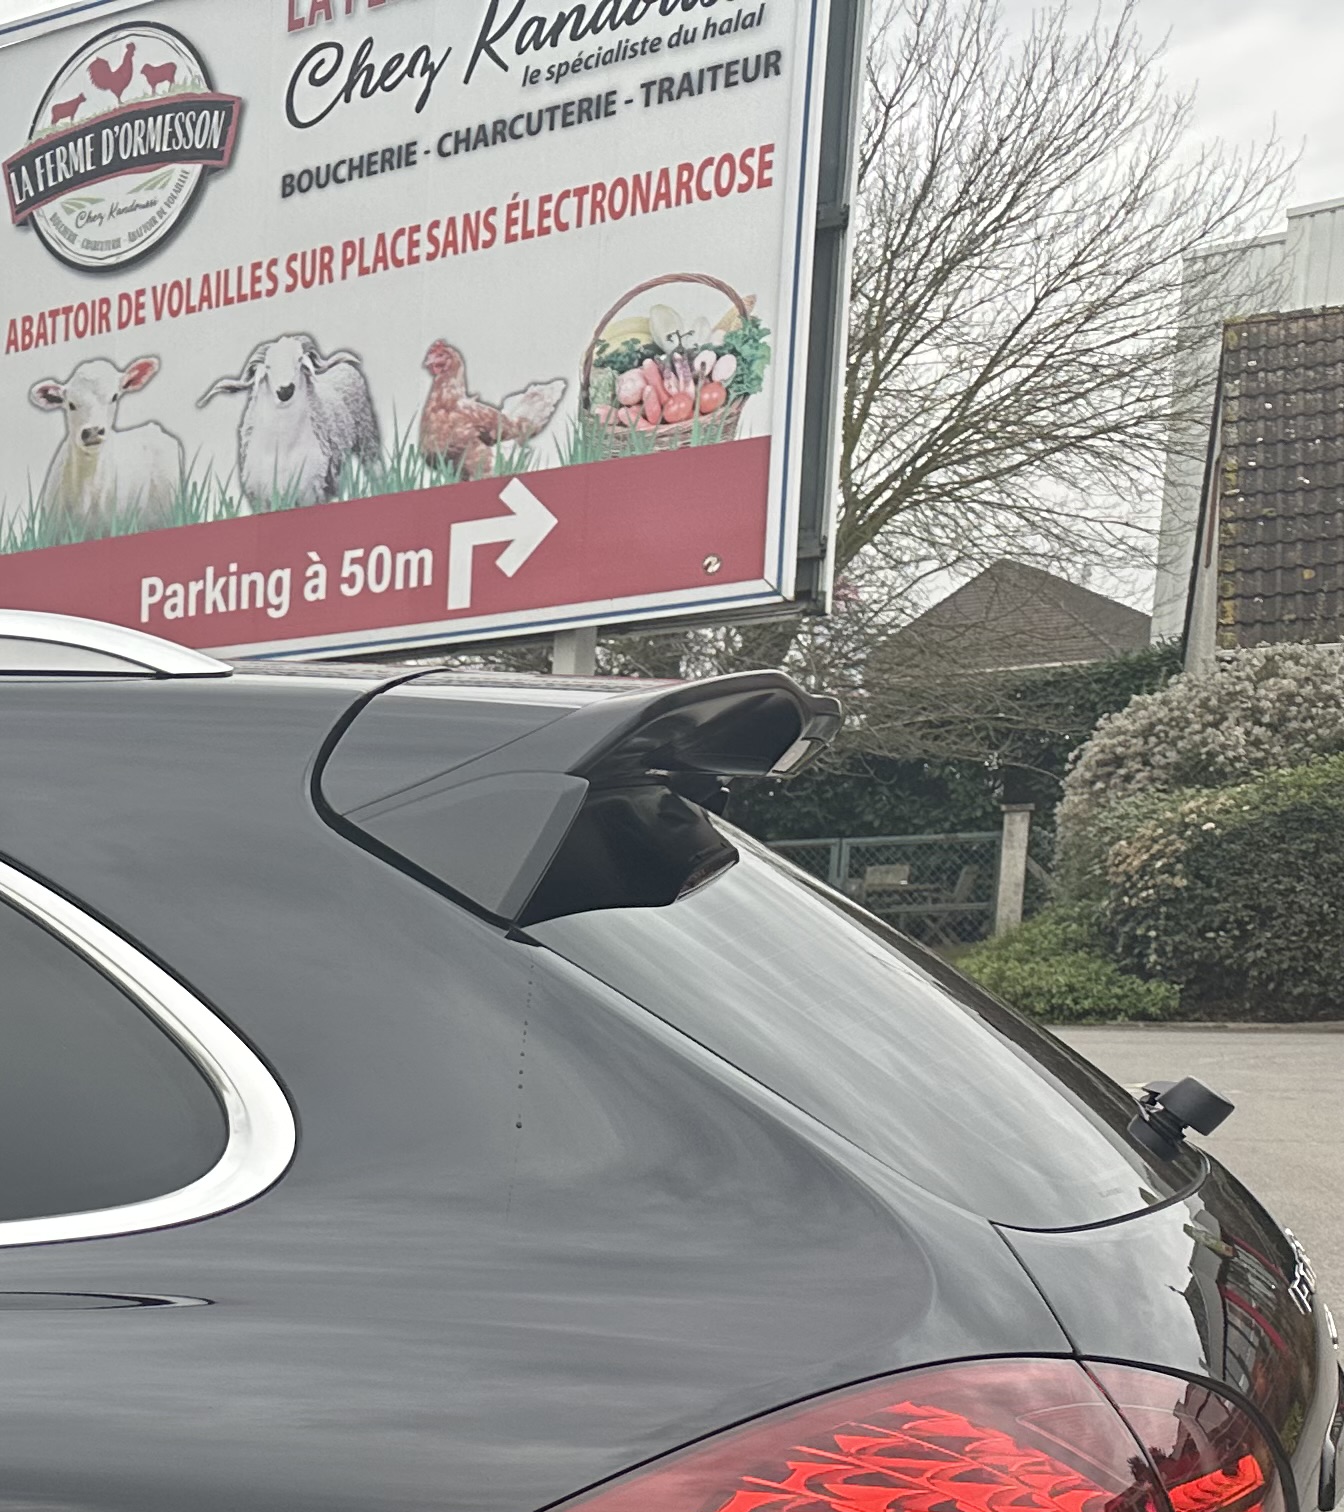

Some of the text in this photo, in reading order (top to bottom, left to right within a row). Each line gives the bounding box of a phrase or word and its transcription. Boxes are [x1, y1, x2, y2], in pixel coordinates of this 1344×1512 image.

[285, 36, 453, 129] Chez
[521, 3, 765, 88] le spécialiste du halal
[10, 109, 226, 206] LA FERME D'ORMESSON
[281, 140, 418, 199] BOUCHERIE
[437, 90, 617, 159] CHARCUTERIE
[641, 49, 782, 109] TRAITEUR
[4, 142, 777, 355] ABATTOIR DE VOLAILLES SUR PLACE SANS ÉLECTRONARCOSE
[140, 545, 434, 623] Parking à 50m
